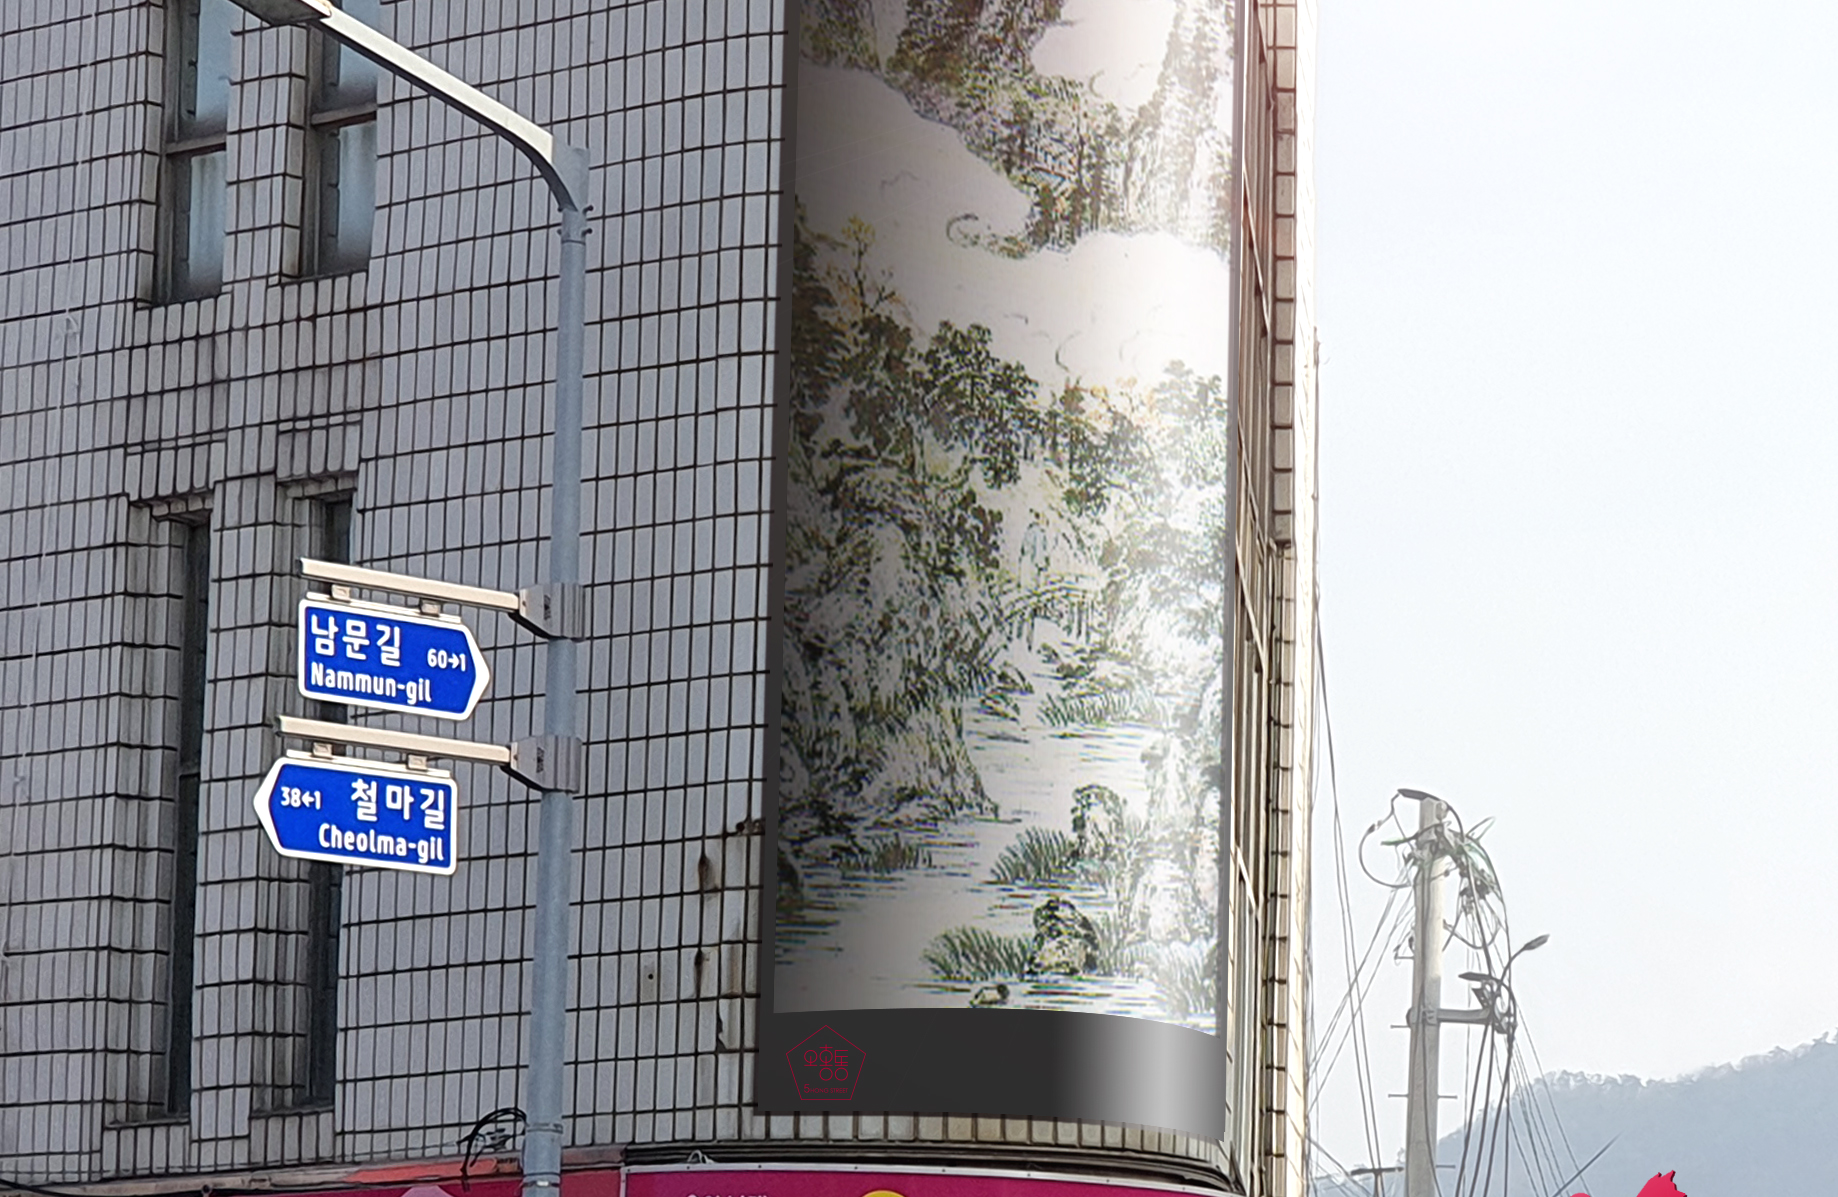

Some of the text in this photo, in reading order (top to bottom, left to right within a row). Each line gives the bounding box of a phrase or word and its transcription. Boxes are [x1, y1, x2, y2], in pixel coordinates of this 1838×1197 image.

[311, 614, 401, 668] 남문길
[310, 662, 432, 706] Nammun-gil
[351, 778, 445, 831] 철마길
[318, 823, 445, 863] Cheolma-gil
